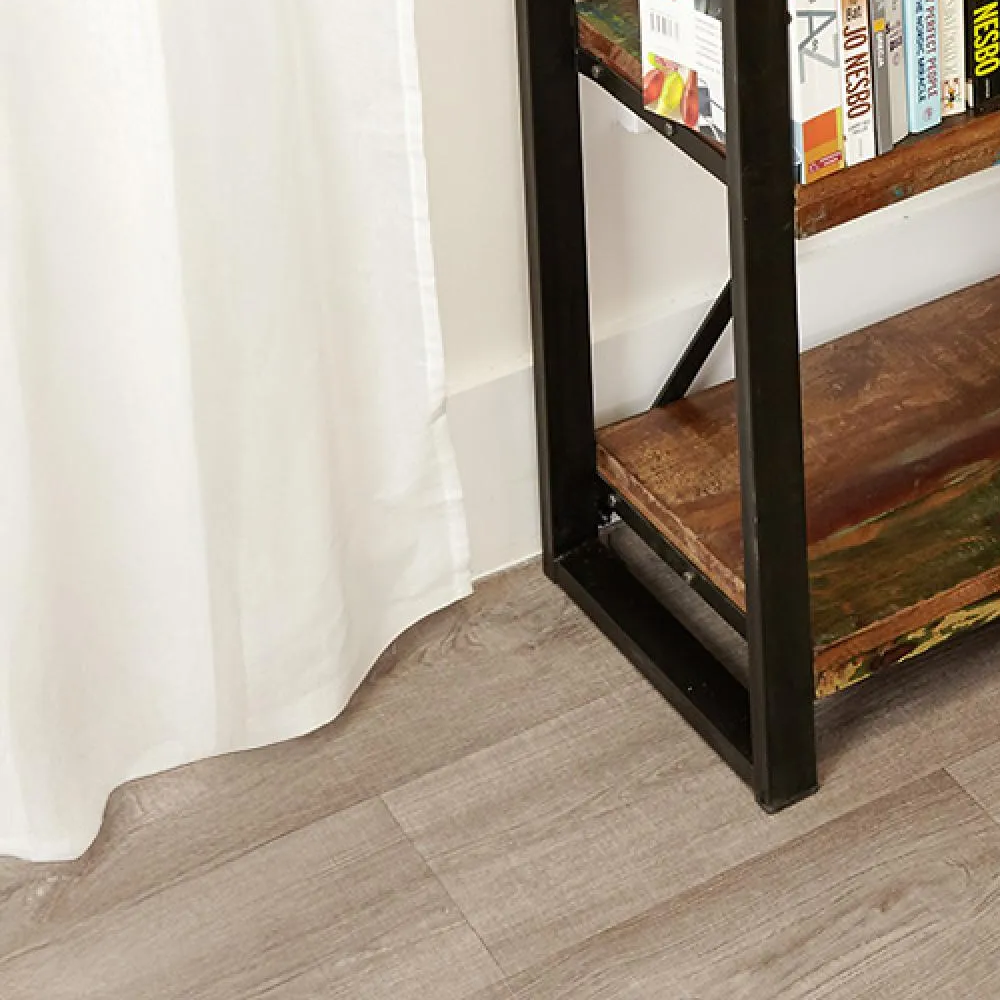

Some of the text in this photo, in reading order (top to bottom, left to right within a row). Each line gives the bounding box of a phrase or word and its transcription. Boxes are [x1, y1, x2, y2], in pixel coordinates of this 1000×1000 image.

[843, 25, 869, 51] JO
[925, 5, 937, 54] PERFECT
[926, 57, 938, 99] PEOPLE
